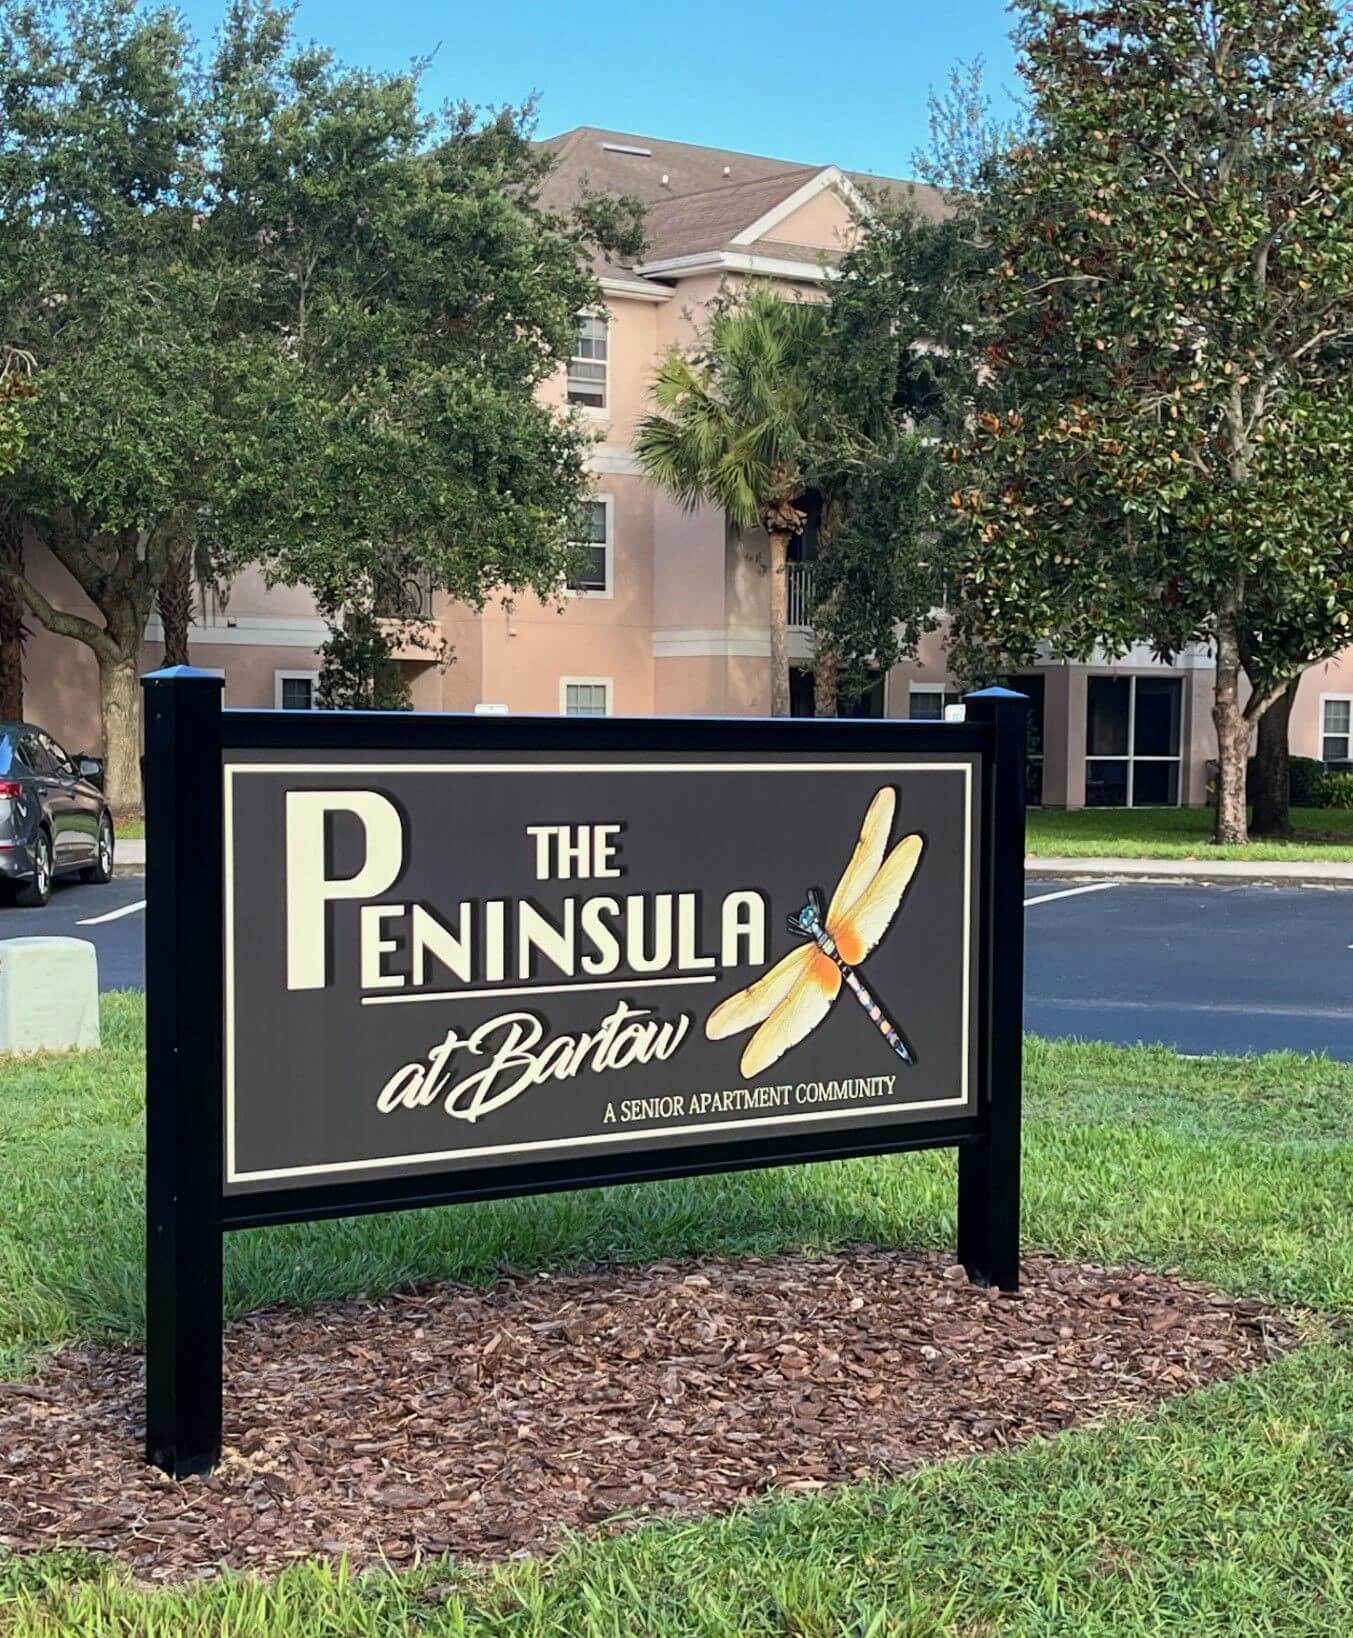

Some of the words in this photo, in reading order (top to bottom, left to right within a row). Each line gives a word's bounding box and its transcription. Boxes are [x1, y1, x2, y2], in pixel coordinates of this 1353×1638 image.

[285, 790, 766, 991] PENINSULA
[526, 824, 622, 880] THE
[376, 1029, 470, 1114] at
[444, 1000, 690, 1123] Bartow
[603, 1102, 617, 1124] A
[620, 1095, 686, 1122] SENIOR
[688, 1085, 793, 1115] APARTMENT
[795, 1075, 897, 1104] COMMUNITY
